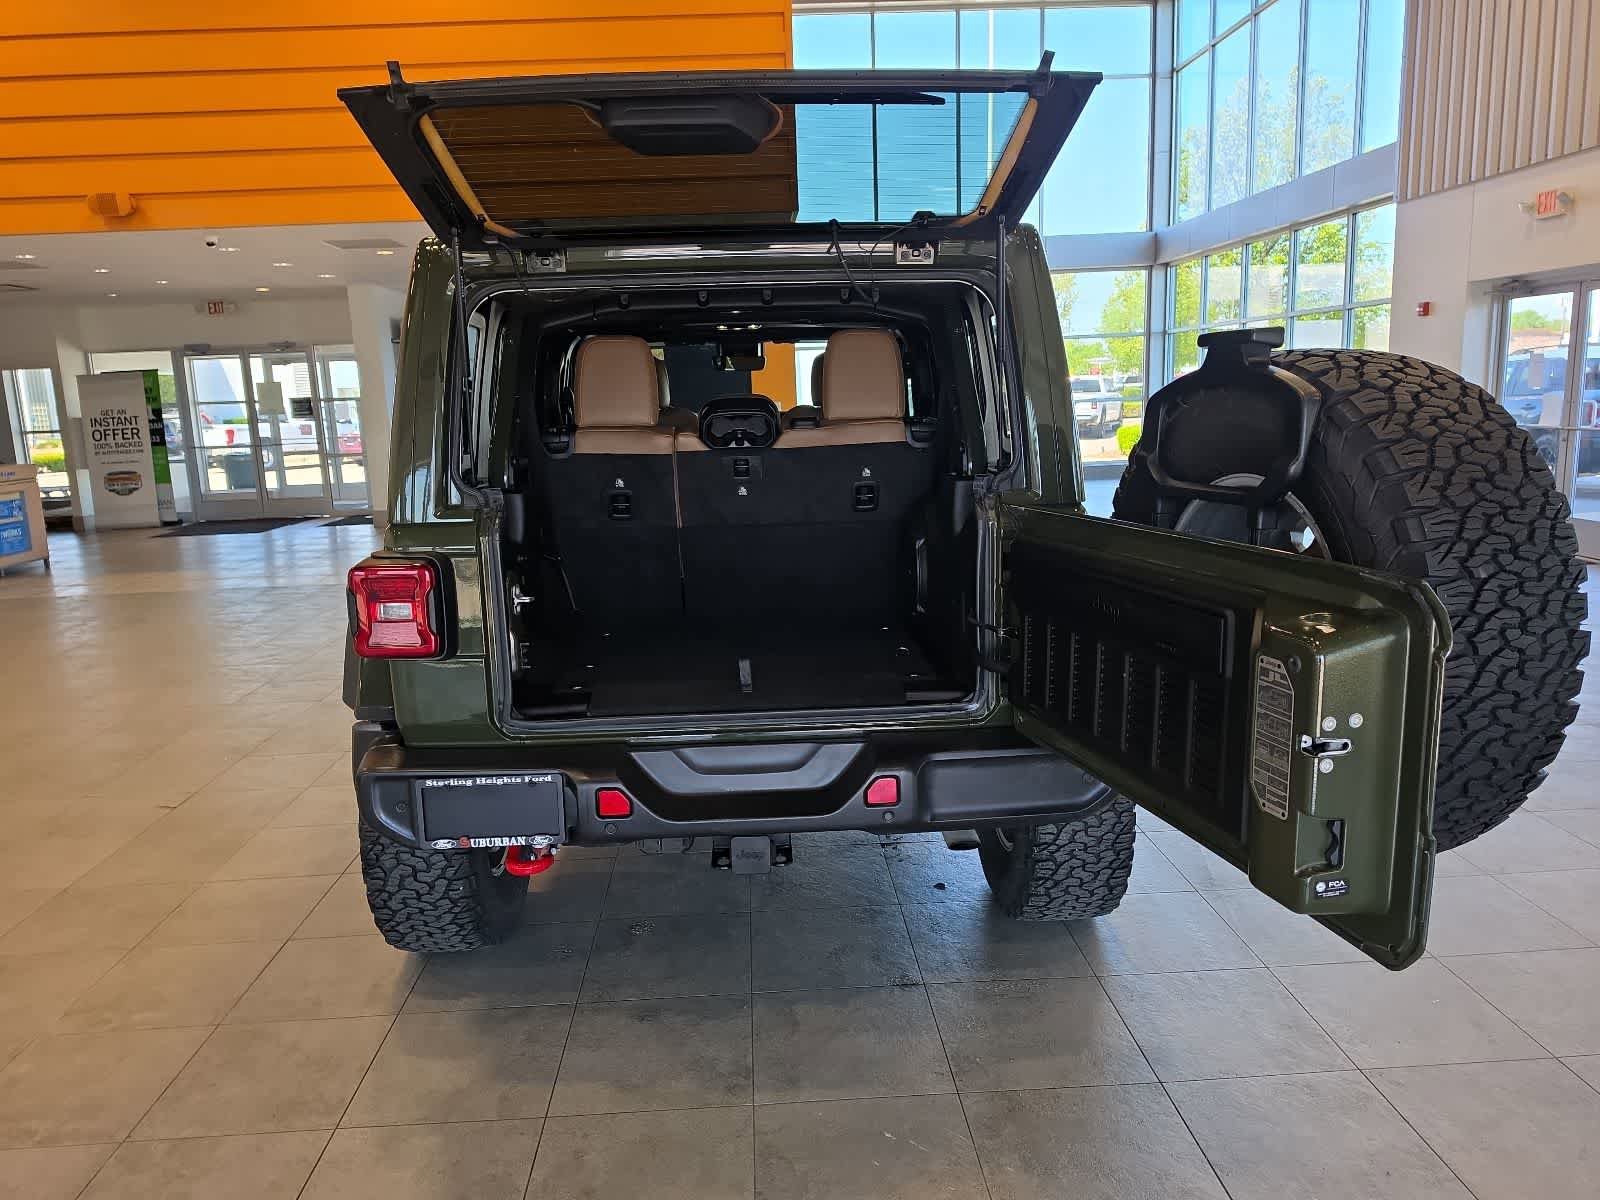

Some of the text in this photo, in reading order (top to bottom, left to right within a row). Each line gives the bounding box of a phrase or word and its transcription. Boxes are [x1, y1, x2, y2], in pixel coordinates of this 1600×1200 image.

[208, 301, 224, 315] EXIT
[100, 408, 127, 417] GET AN
[90, 415, 140, 428] INSTANT
[92, 427, 141, 442] OFFER
[93, 441, 143, 450] 100% BACKED
[425, 778, 473, 787] Sterling
[475, 776, 522, 786] Heights
[460, 836, 526, 848] SUBURBAN
